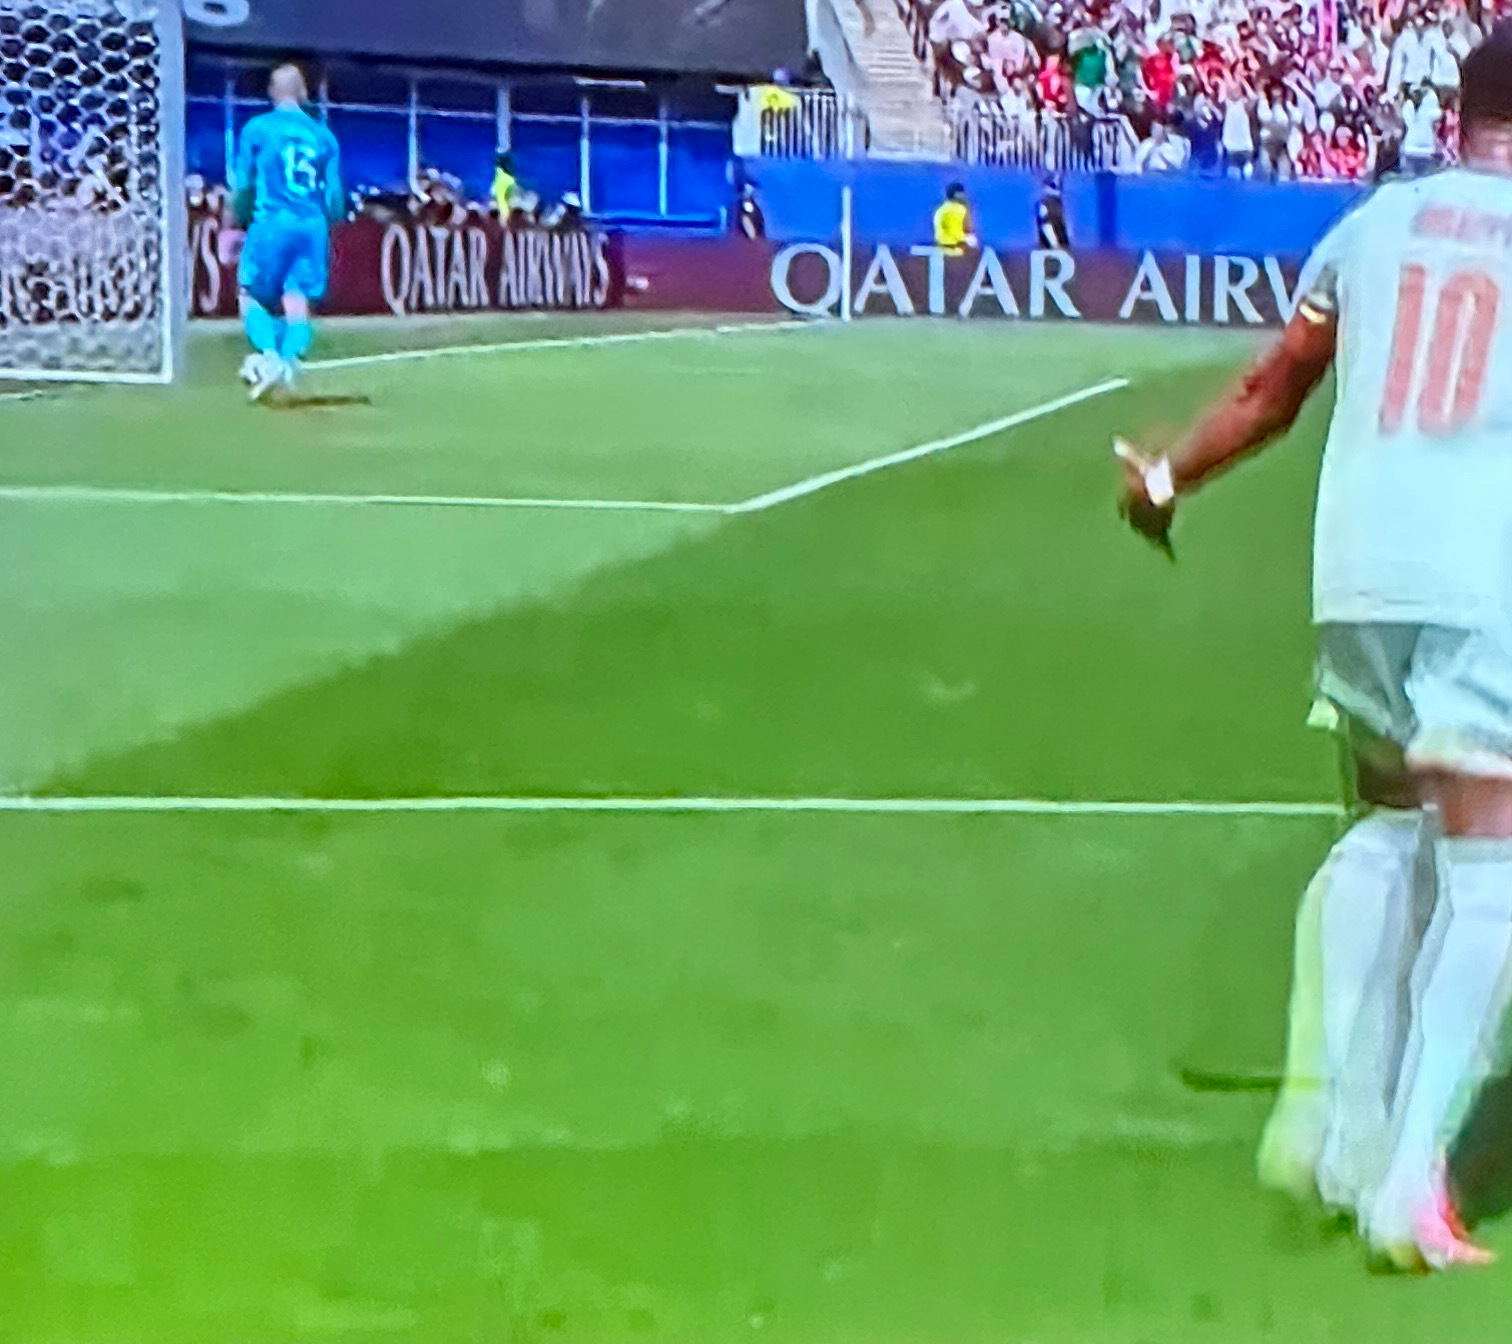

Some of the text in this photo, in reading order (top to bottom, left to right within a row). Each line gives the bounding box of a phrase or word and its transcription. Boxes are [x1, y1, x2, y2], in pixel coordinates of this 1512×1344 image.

[381, 222, 490, 317] QATAR
[770, 242, 1082, 320] QATAR
[1377, 262, 1500, 438] 10
